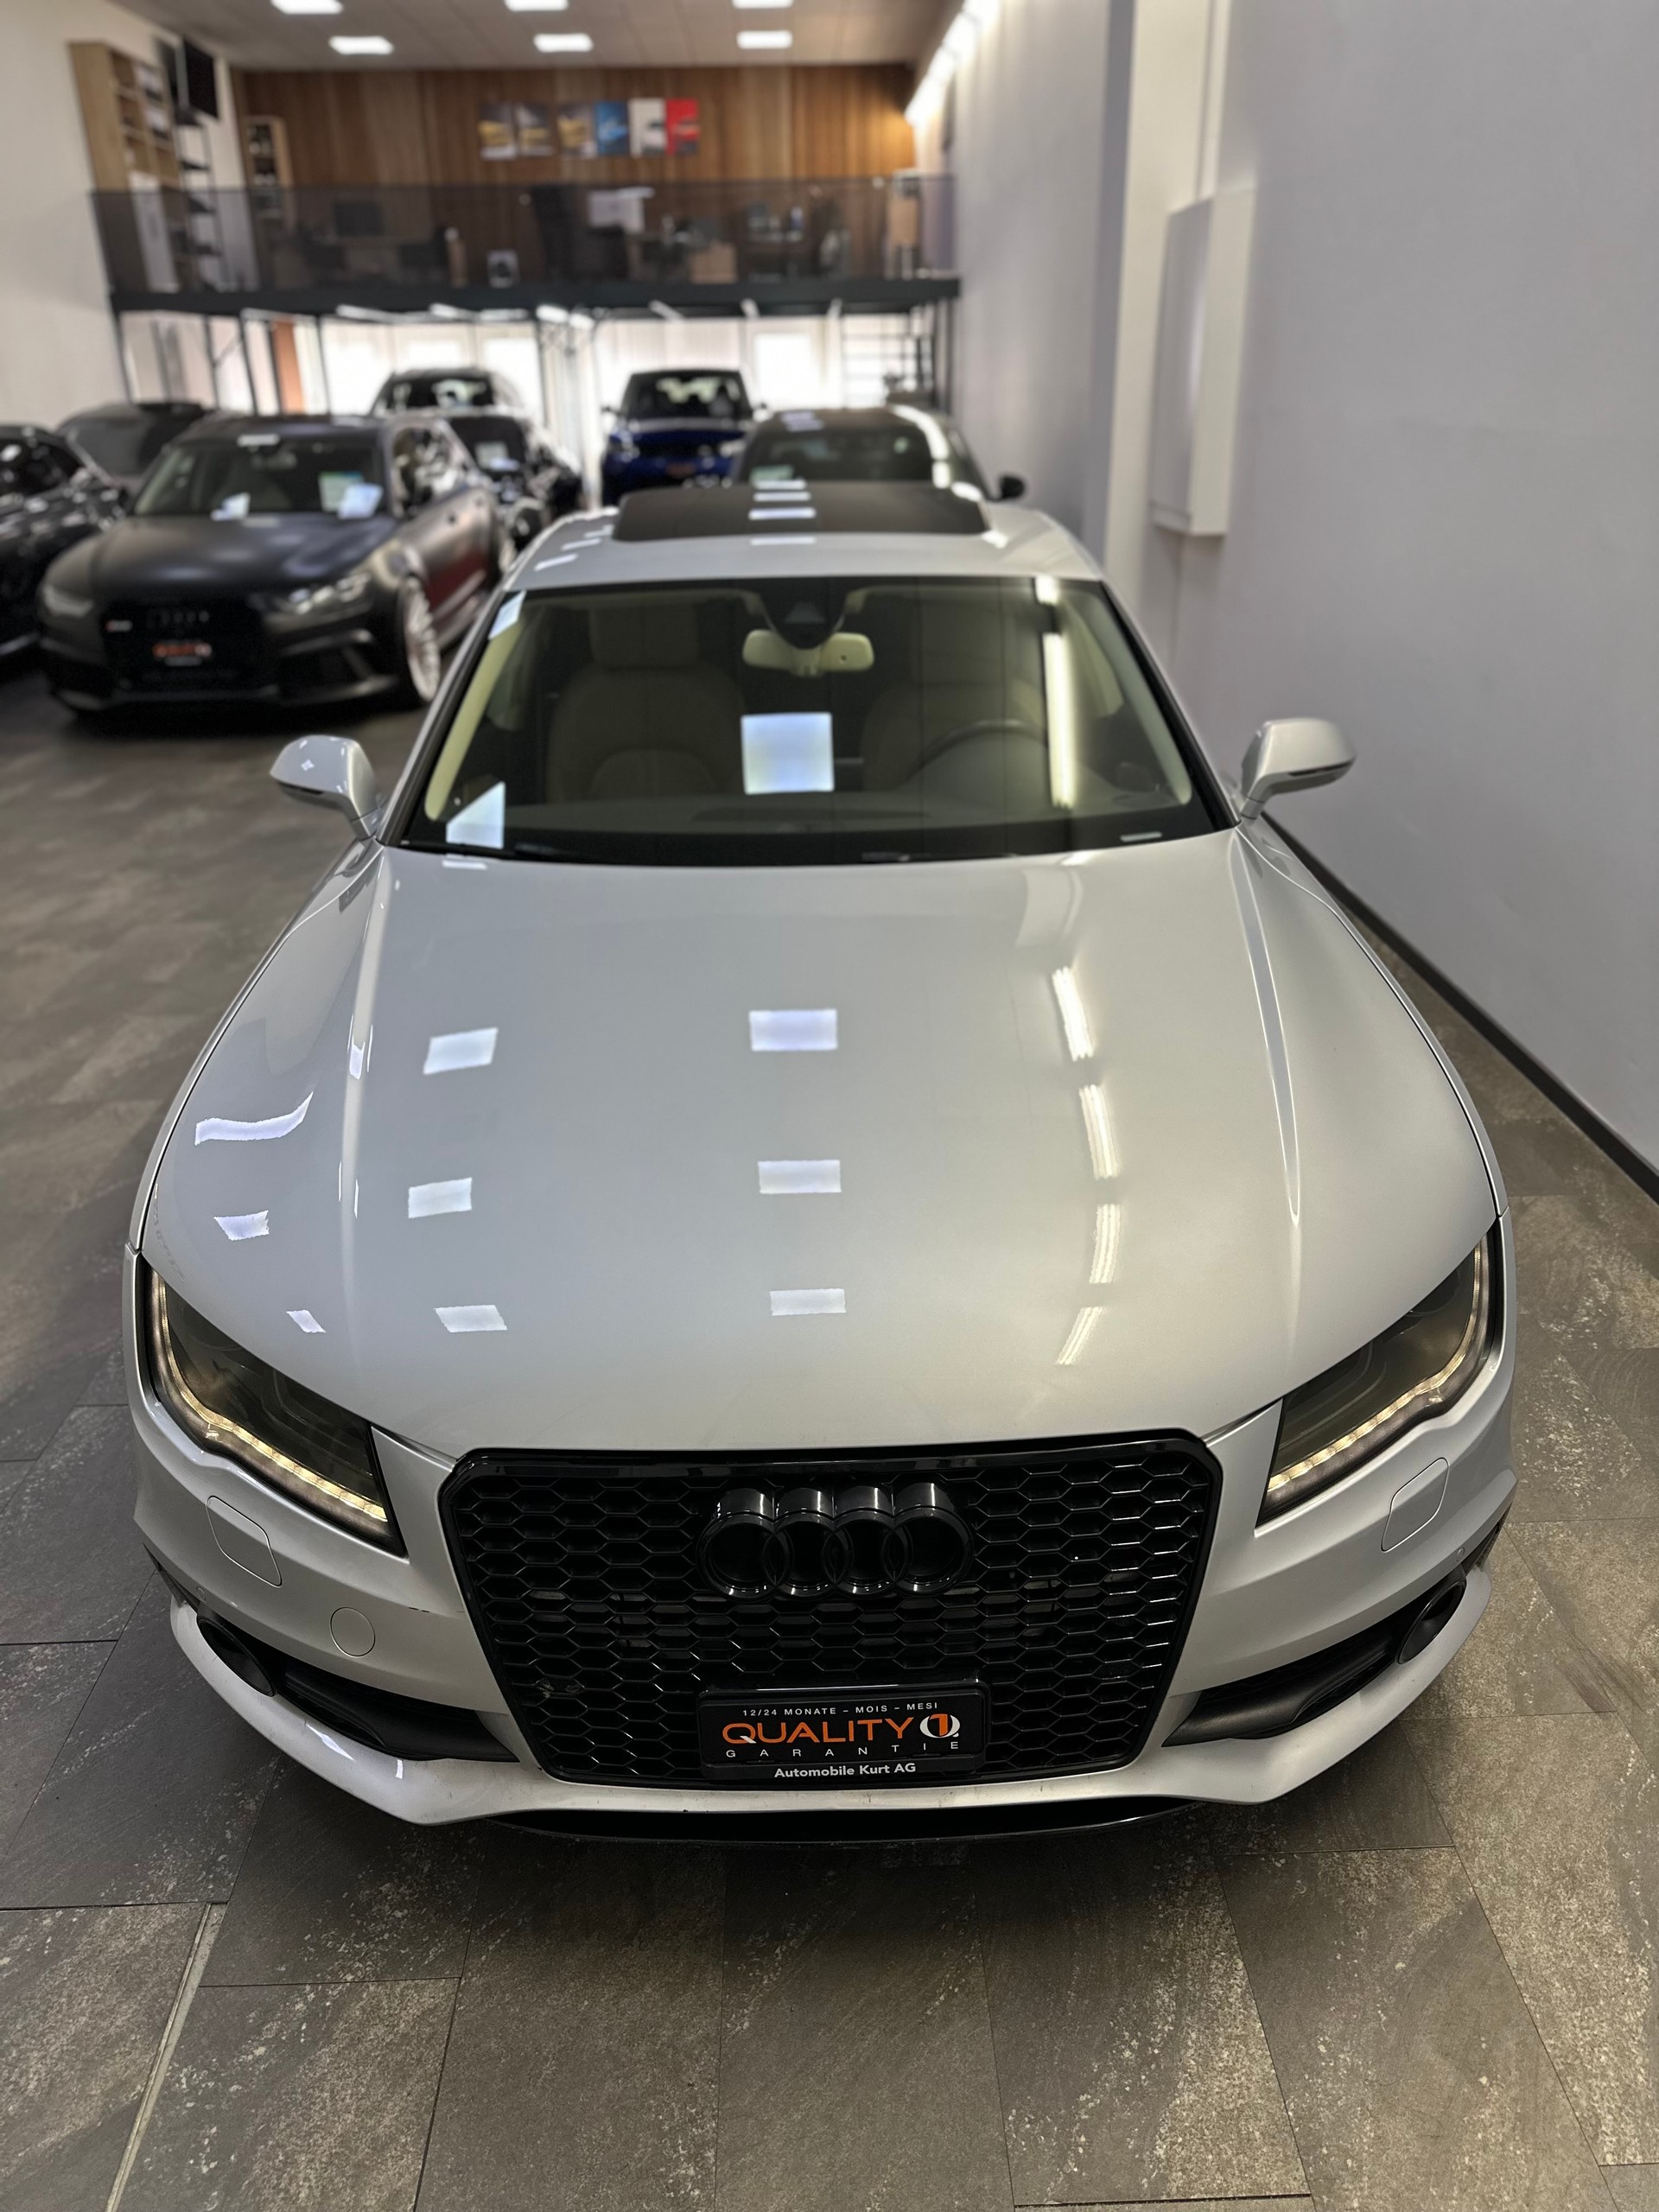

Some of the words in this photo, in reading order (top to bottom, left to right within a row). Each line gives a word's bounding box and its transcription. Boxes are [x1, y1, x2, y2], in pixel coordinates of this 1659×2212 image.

[855, 1705, 887, 1713] MOIS
[907, 1702, 938, 1711] MESI
[722, 1717, 914, 1744] QUALITY
[726, 1741, 959, 1758] GARANTIE
[774, 1765, 855, 1777] Automobile
[859, 1764, 890, 1775] Kurt
[893, 1763, 916, 1773] AG
